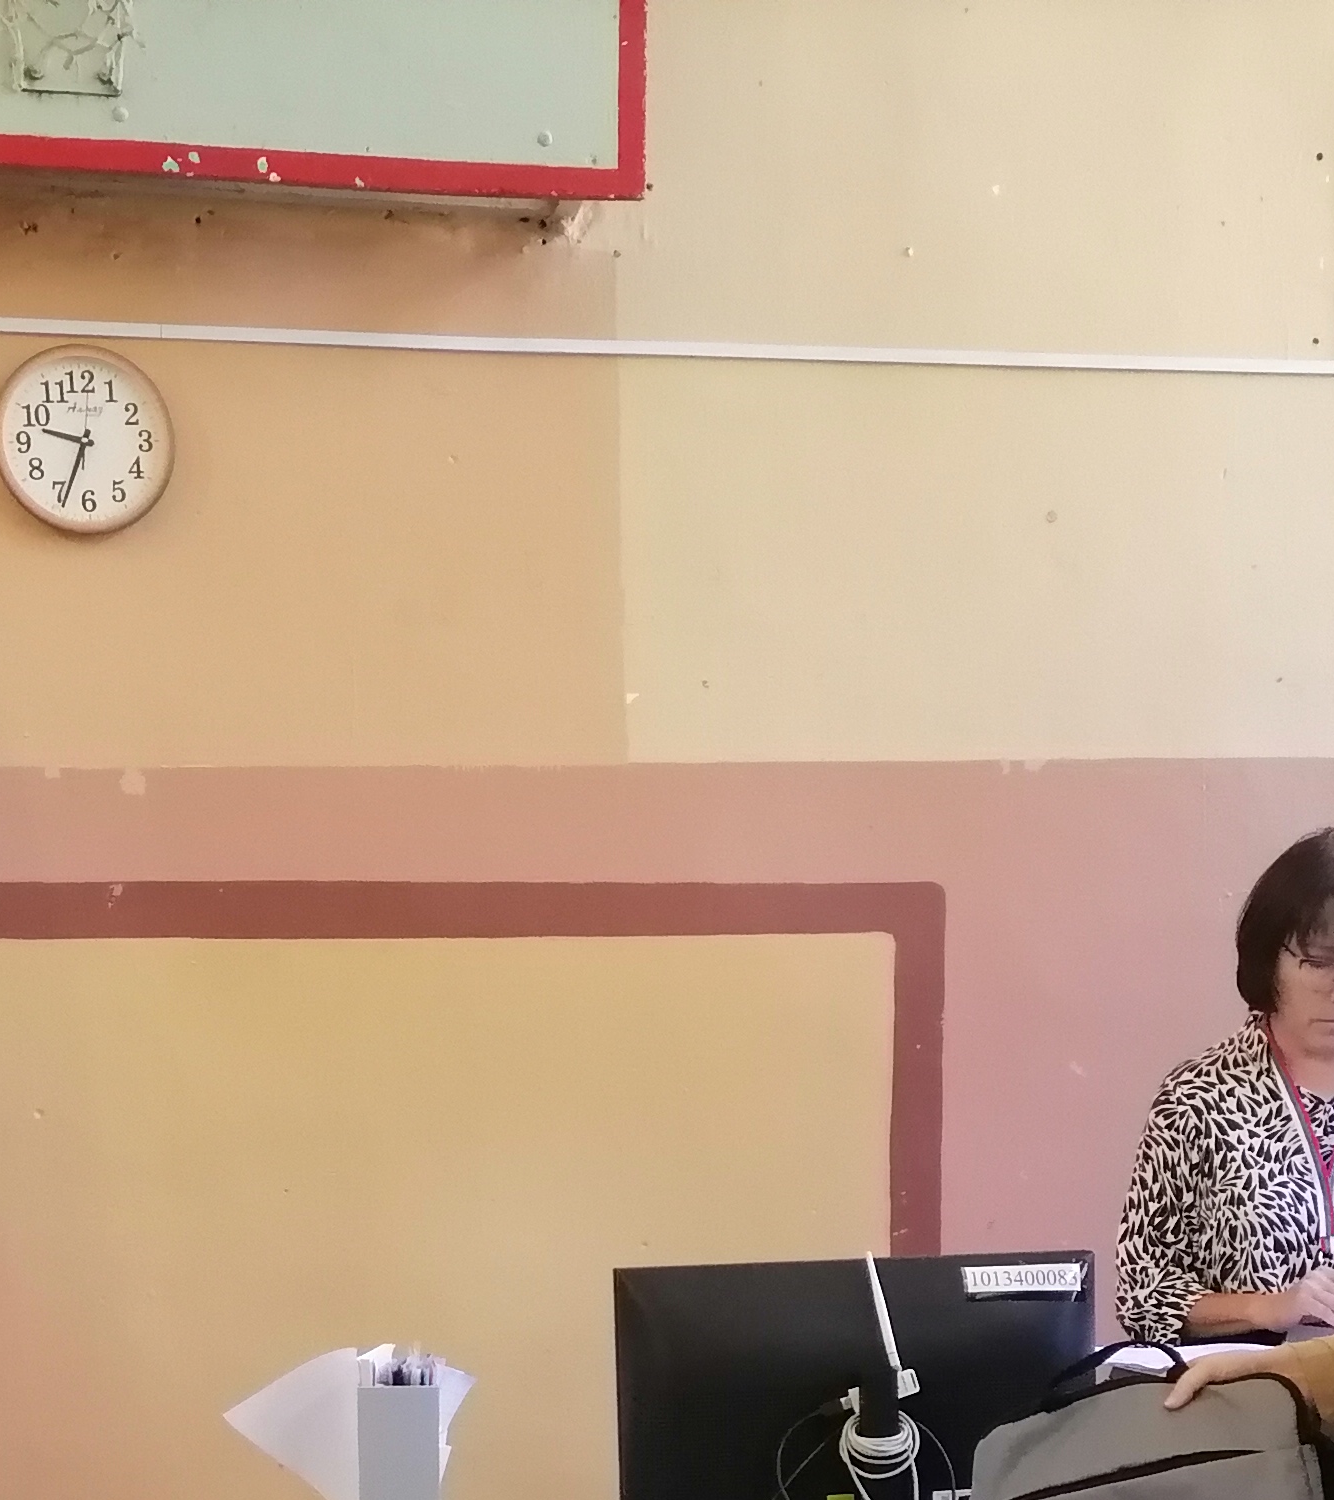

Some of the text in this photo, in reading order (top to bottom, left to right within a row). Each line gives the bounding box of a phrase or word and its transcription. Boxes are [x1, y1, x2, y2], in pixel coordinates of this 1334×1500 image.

[40, 379, 69, 403] 11
[65, 369, 96, 394] 12
[104, 379, 118, 403] 1
[22, 403, 50, 428] 10
[124, 402, 139, 426] 2
[15, 430, 32, 454] 9
[138, 429, 153, 453] 3
[28, 457, 45, 480] 8
[128, 456, 144, 480] 4
[52, 480, 66, 503] 7
[81, 489, 97, 513] 6
[112, 479, 126, 502] 5
[971, 1269, 1078, 1287] 1013400083
